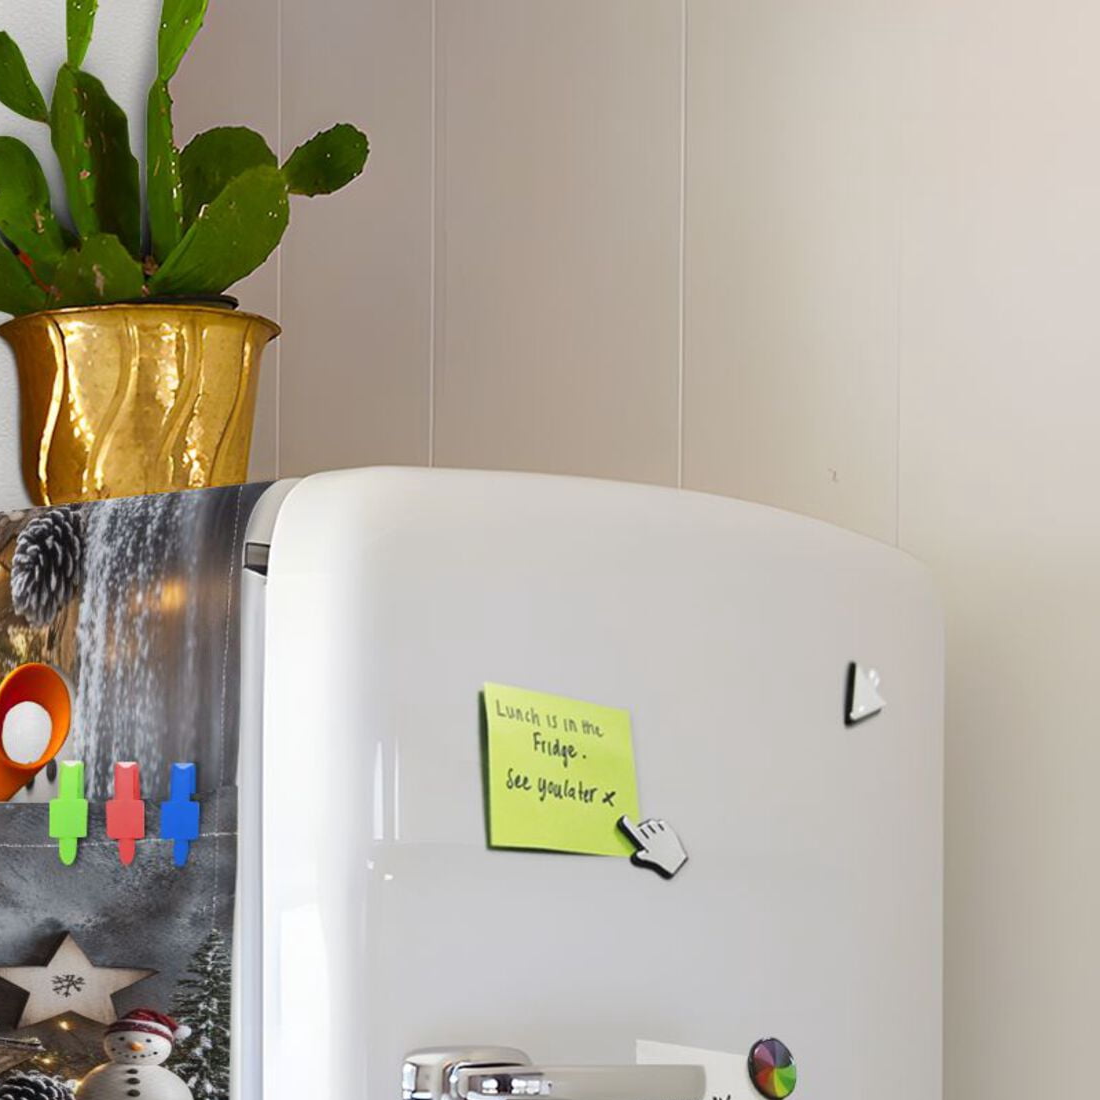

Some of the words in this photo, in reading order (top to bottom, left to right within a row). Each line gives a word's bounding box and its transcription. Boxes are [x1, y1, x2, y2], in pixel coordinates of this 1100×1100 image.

[495, 699, 541, 727] Lunch
[563, 718, 578, 733] in
[582, 720, 604, 738] the
[505, 767, 532, 790] See
